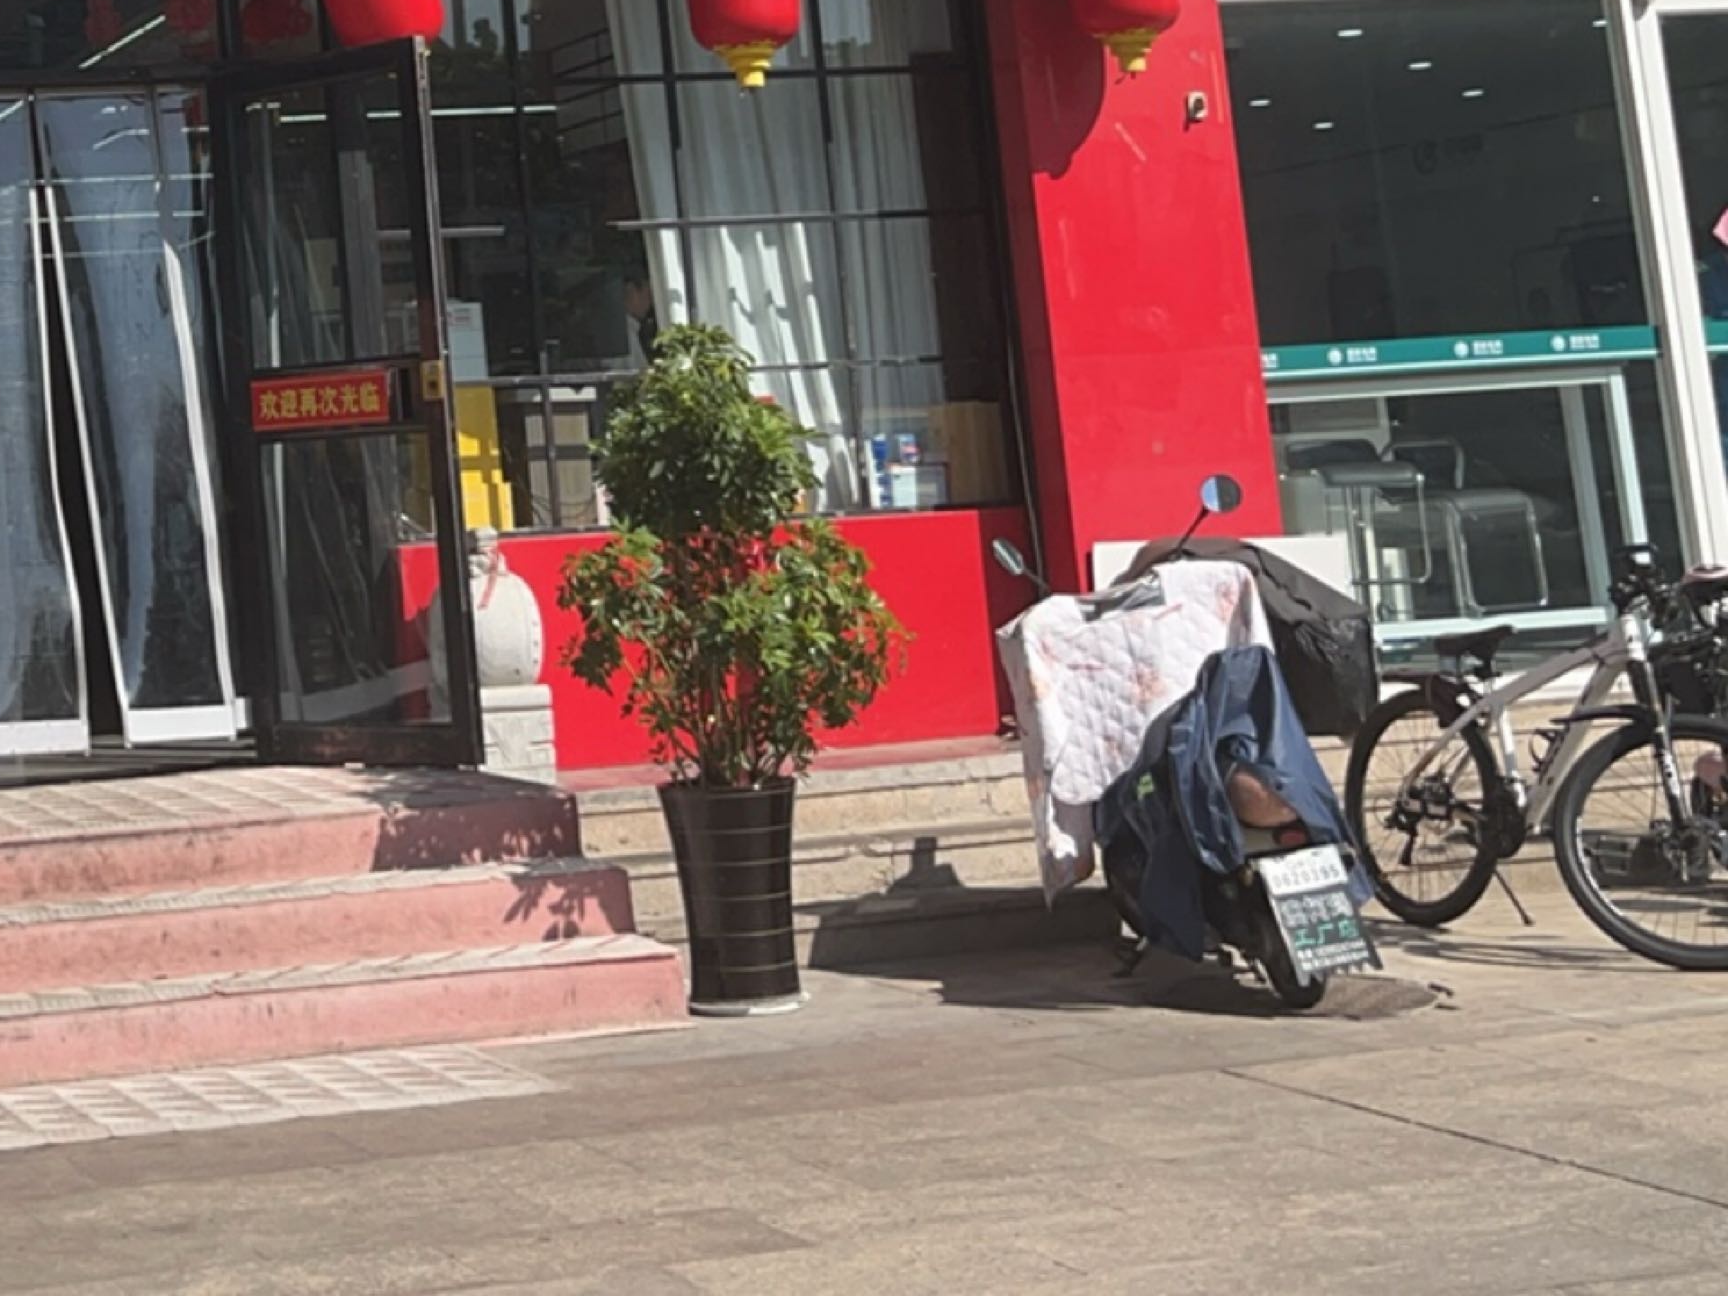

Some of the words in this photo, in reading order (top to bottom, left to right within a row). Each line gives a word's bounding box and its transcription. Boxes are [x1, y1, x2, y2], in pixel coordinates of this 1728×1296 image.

[259, 381, 380, 421] 欢迎再次光临
